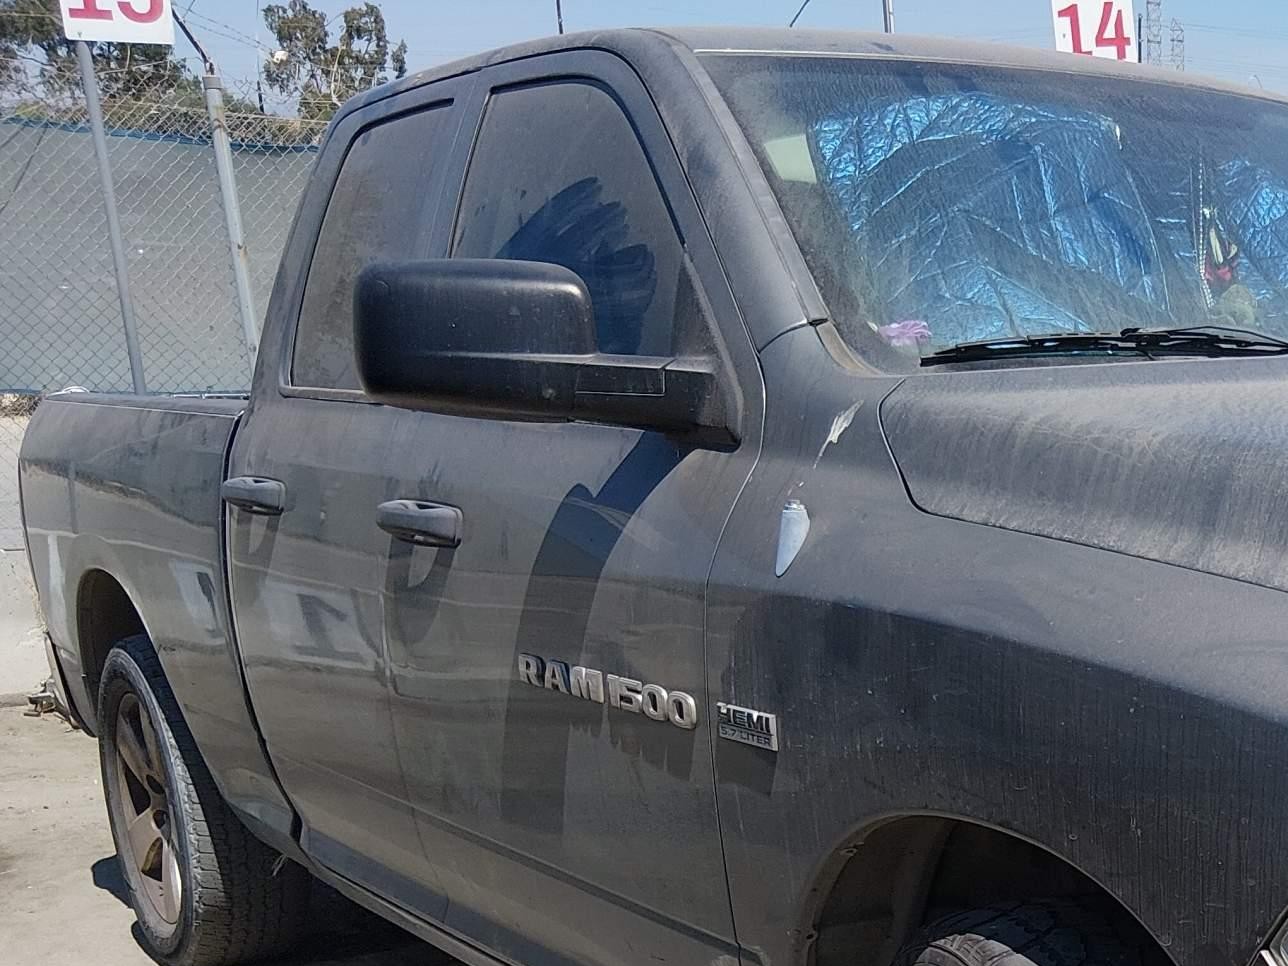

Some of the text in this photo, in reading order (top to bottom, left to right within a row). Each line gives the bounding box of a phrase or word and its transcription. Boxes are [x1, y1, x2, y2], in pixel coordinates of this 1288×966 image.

[1057, 1, 1131, 60] 14
[517, 652, 697, 730] RAM 1500
[717, 704, 774, 736] HEMI
[719, 725, 737, 737] 5.7
